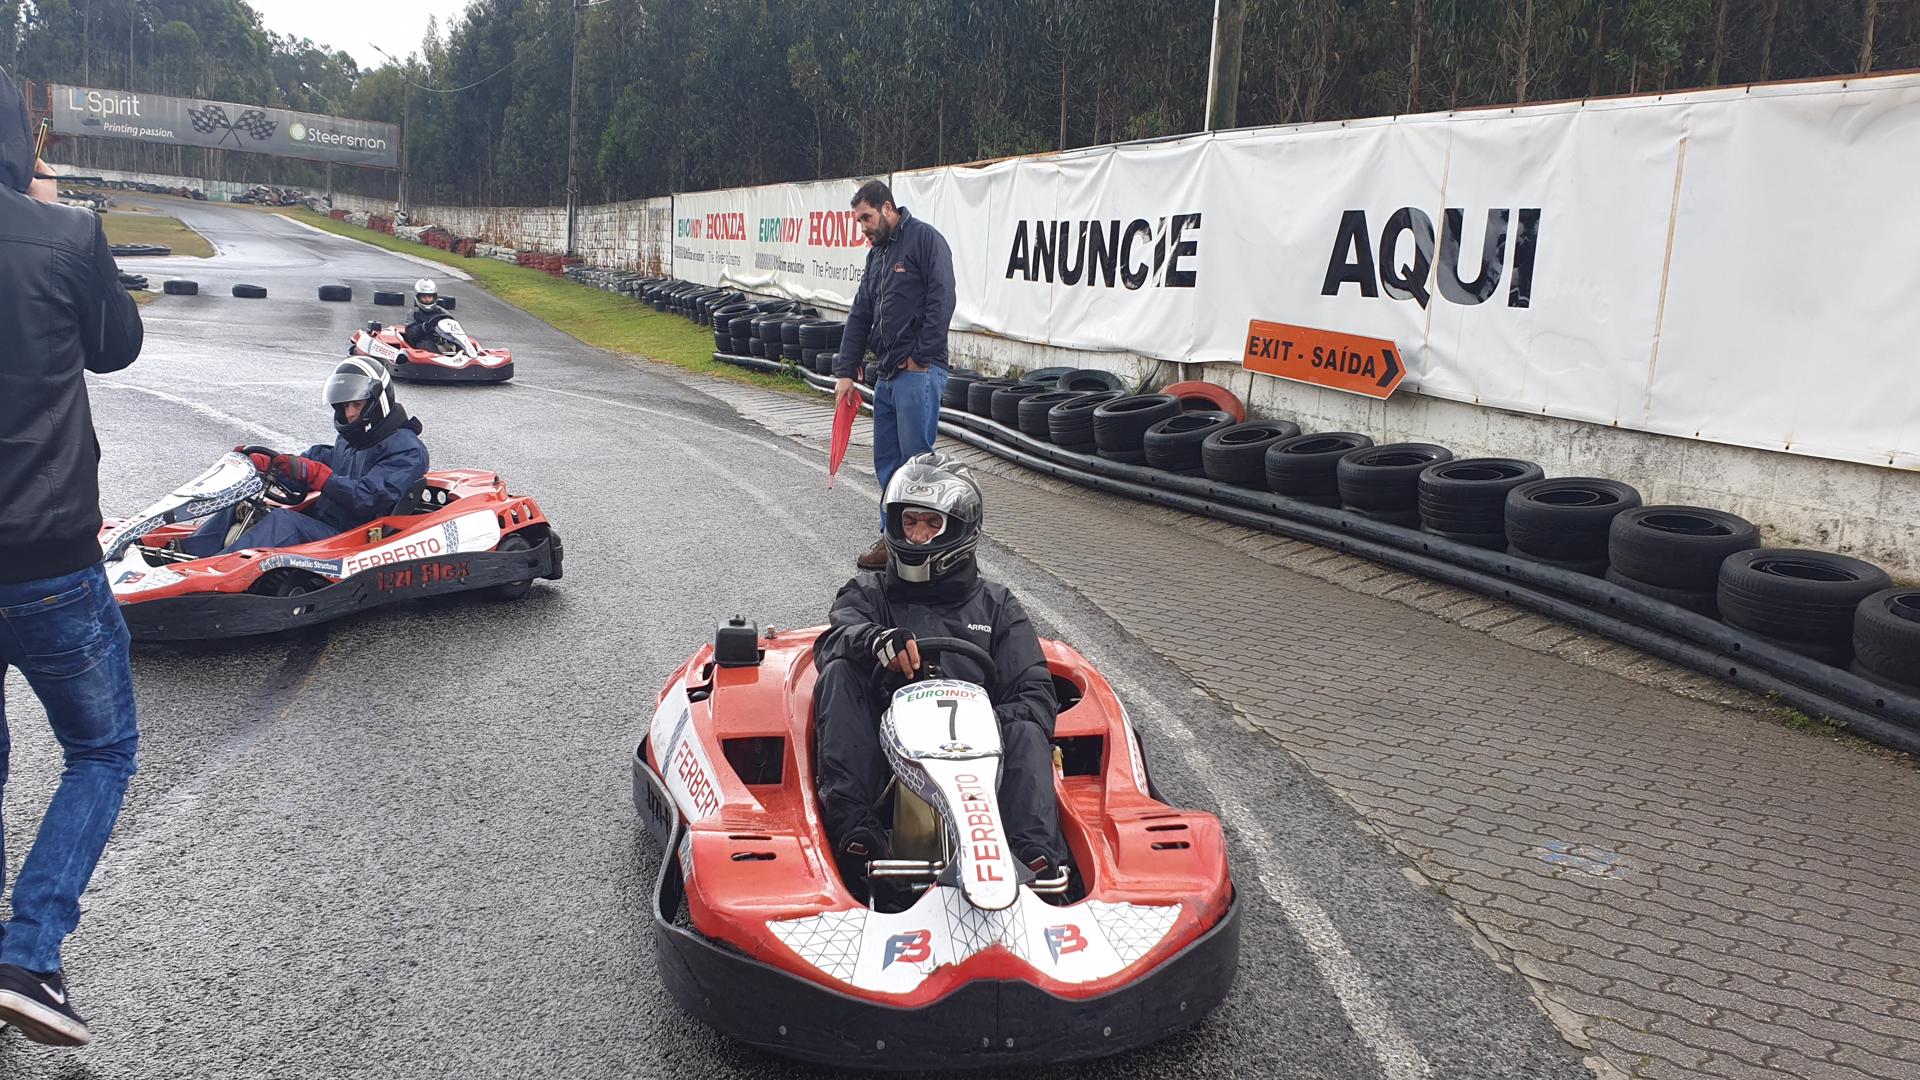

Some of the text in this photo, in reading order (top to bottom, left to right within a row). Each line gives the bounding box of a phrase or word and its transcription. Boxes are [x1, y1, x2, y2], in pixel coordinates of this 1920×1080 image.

[87, 91, 141, 118] Spirit
[103, 122, 175, 138] Printing passion.
[308, 127, 386, 150] Steersman
[759, 217, 803, 244] EUROINDY
[808, 210, 873, 248] HOND
[812, 259, 824, 276] The
[825, 261, 842, 279] Power
[1006, 212, 1201, 291] ANUNCIE
[1320, 206, 1542, 311] AQUI
[1248, 335, 1293, 361] EXIT
[1311, 345, 1376, 378] SAÍDA
[290, 559, 338, 571] Metallic Structures
[347, 537, 442, 575] FERBERTO
[907, 689, 977, 702] EUROINDY
[936, 700, 958, 741] 7
[673, 739, 719, 819] FERBERT
[954, 774, 1004, 882] FERBERTO
